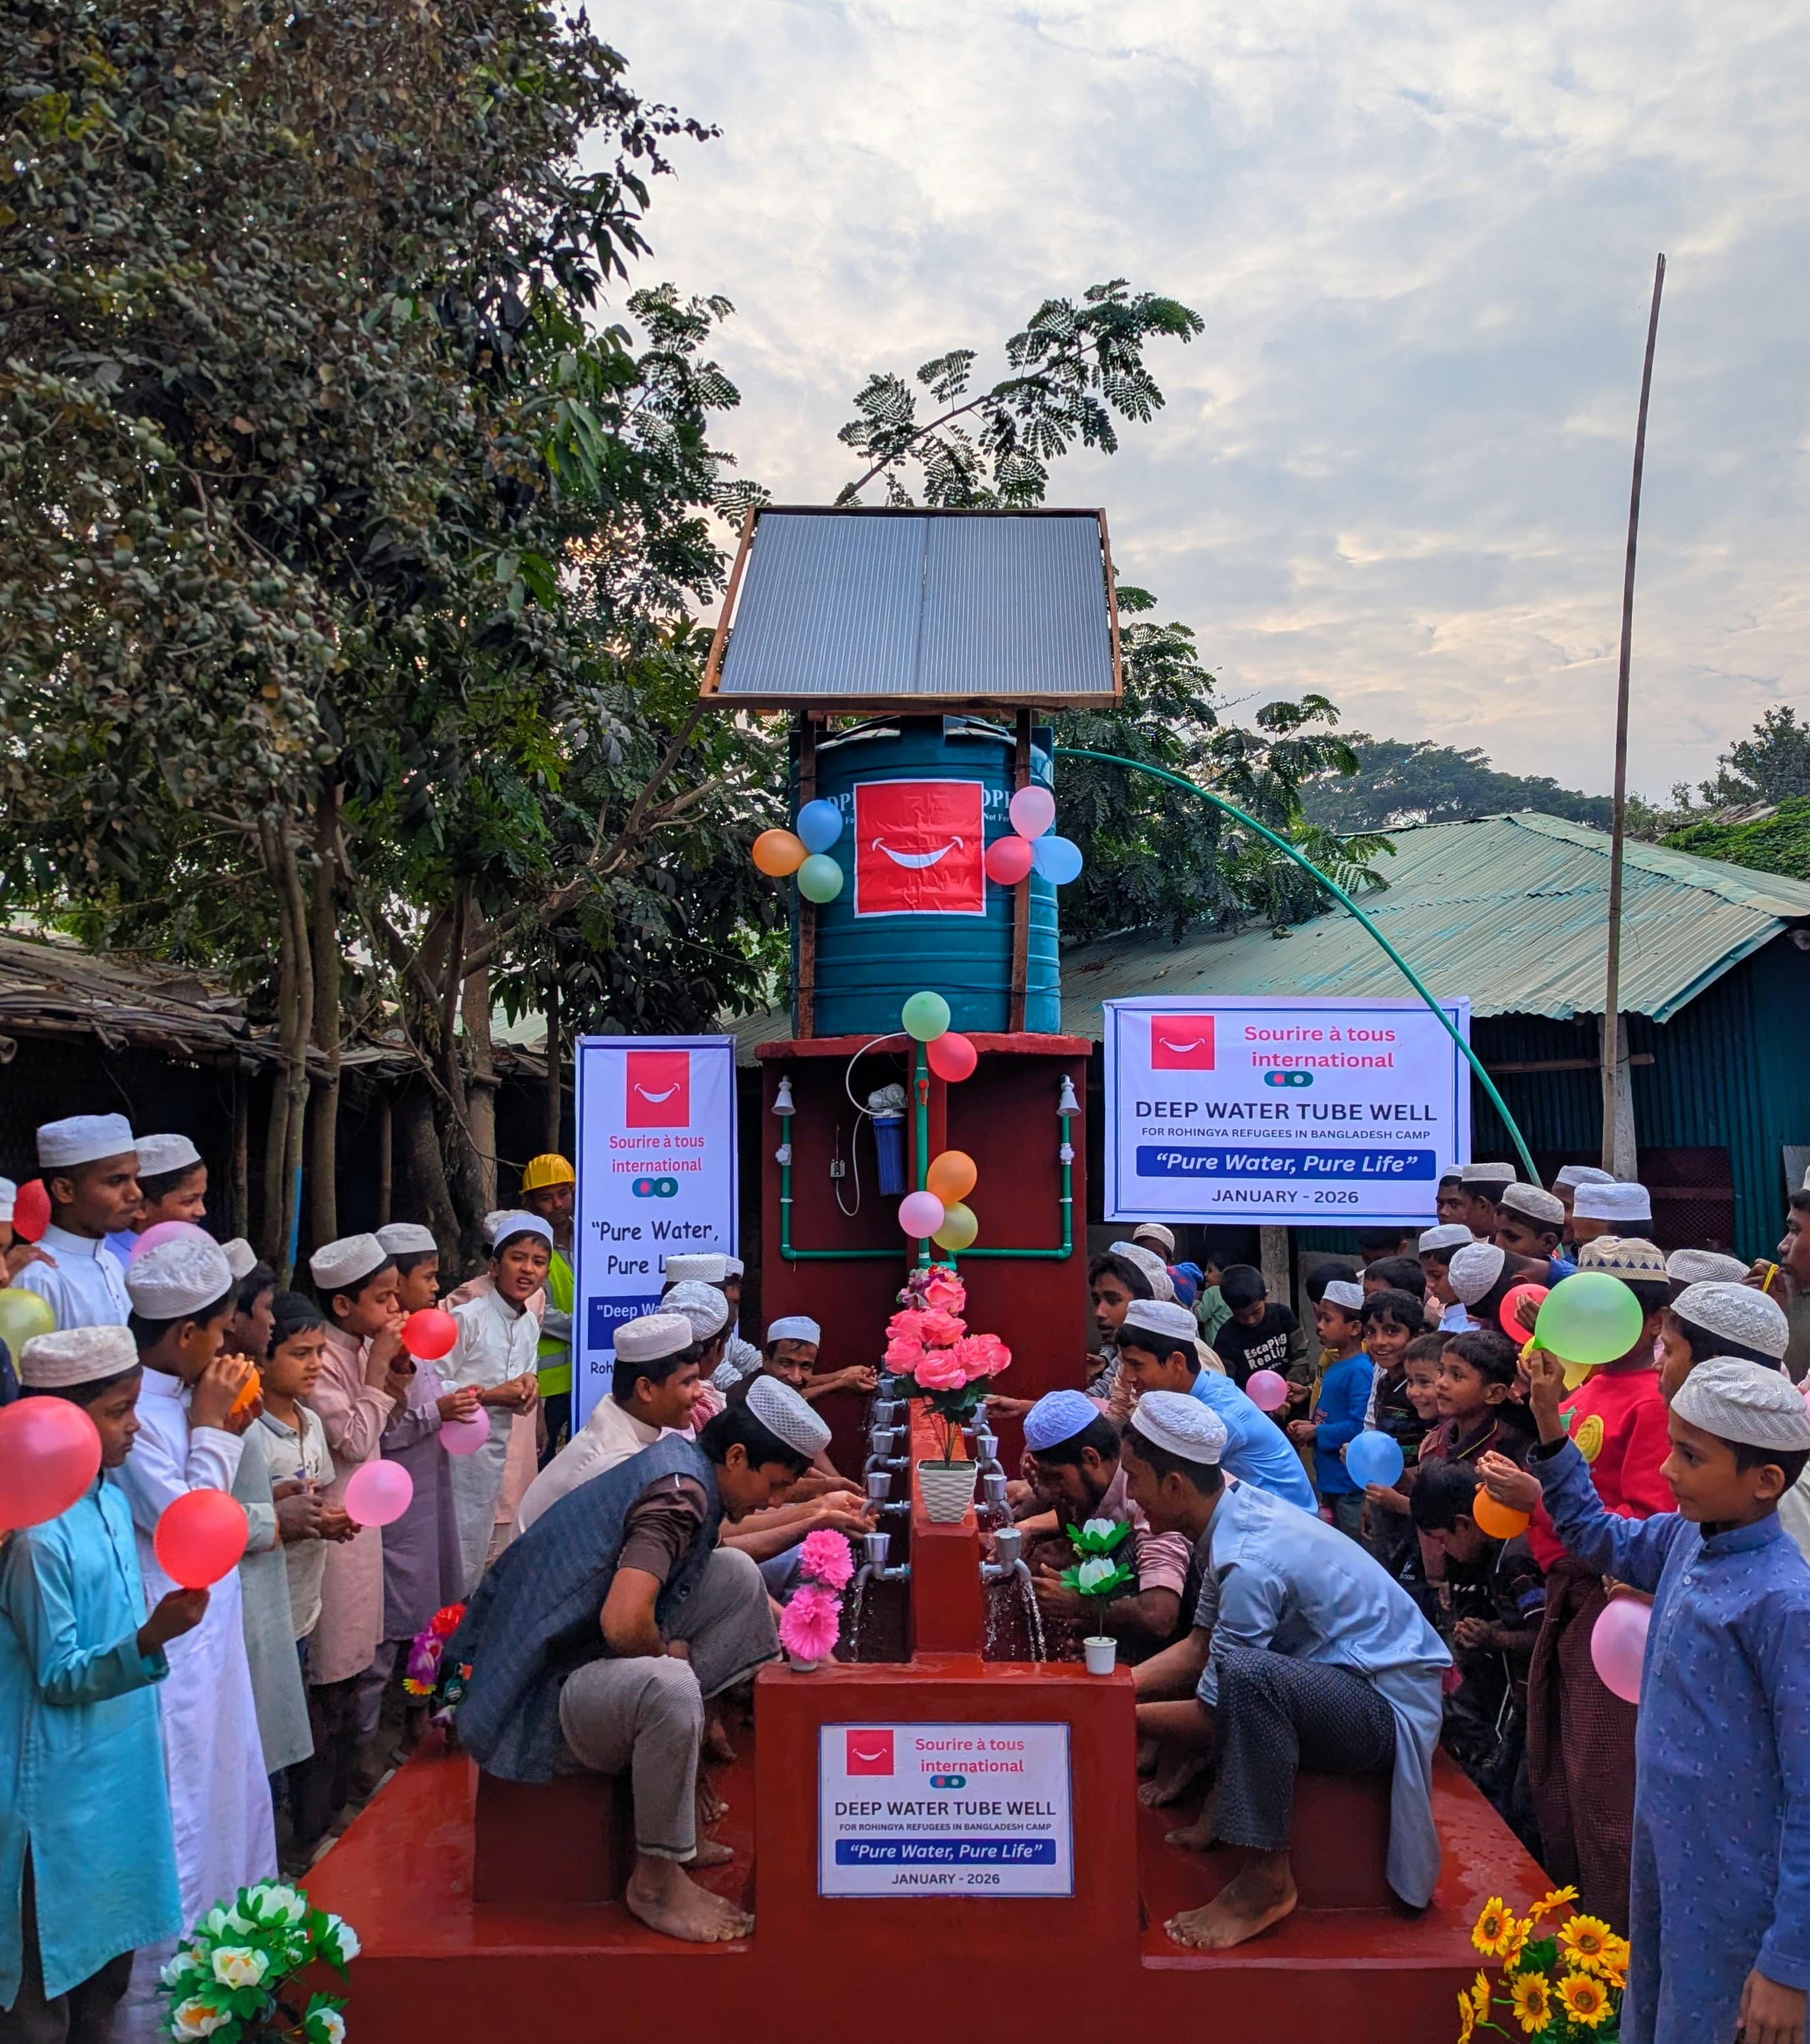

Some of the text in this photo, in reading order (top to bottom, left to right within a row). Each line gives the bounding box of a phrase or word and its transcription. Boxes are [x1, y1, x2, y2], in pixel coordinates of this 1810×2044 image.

[983, 812, 996, 821] Not
[1244, 1025, 1396, 1042] Sourire à tous
[1252, 1051, 1394, 1068] international
[1136, 1101, 1438, 1121] DEEP WATER TUBE WELL
[1142, 1127, 1431, 1140] FOR ROHINGYA REFUGEES IN BANGLADESH CAMP
[609, 1134, 704, 1149] Sourire à tous
[612, 1157, 702, 1173] international
[1156, 1152, 1418, 1175] “Pure Water, Pure Life”
[1211, 1190, 1298, 1203] JANUARY
[1314, 1190, 1359, 1204] 2026
[591, 1220, 719, 1242] “Pure Water,
[607, 1255, 649, 1275] Pure
[597, 1304, 637, 1320] "Deep
[915, 1738, 1025, 1751] Sourire à tous
[921, 1759, 1024, 1774] international
[835, 1801, 1056, 1816] DEEP WATER TUBE WELL
[839, 1823, 857, 1832] FOR
[850, 1843, 1043, 1861] “Pure Water, Pure Life”
[891, 1873, 956, 1885] JANUARY
[967, 1873, 1000, 1885] 2026
